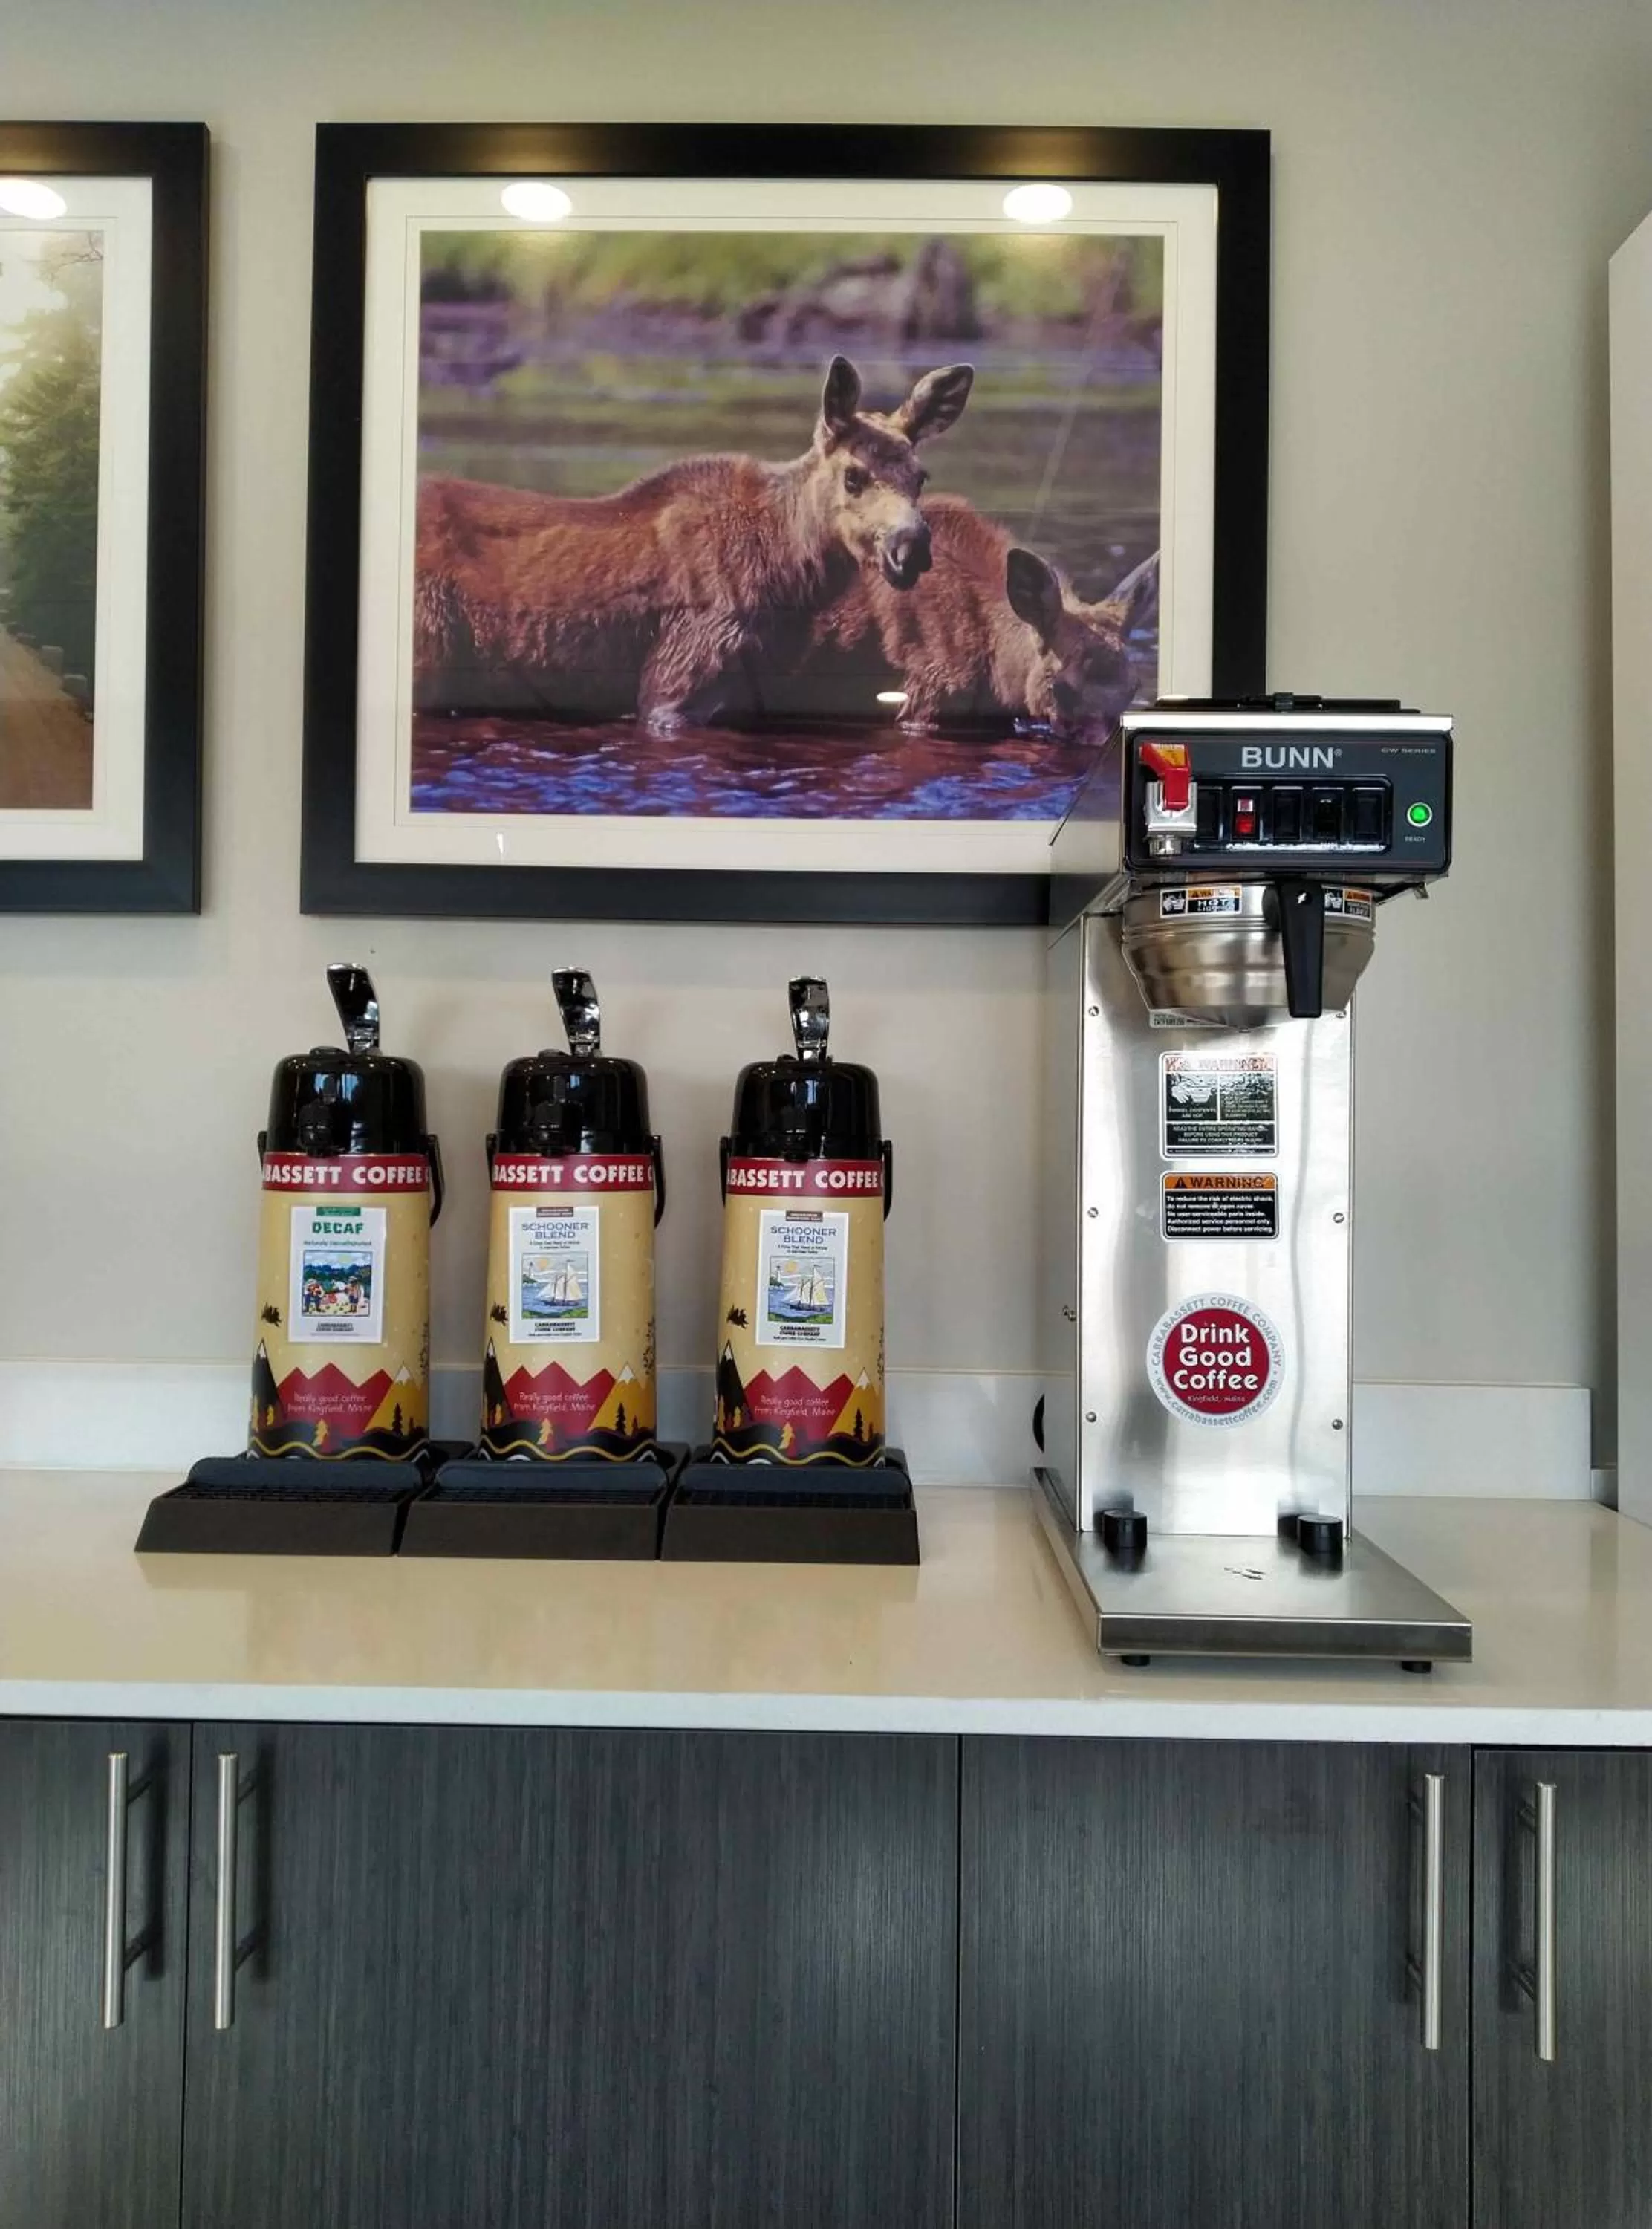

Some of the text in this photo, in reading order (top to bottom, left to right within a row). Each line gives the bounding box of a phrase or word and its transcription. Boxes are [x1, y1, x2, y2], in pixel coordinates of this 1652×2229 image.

[352, 1166, 423, 1184] COFFEE
[573, 1164, 644, 1184] COFFEE
[727, 1169, 806, 1188] BASSETT
[814, 1170, 878, 1189] COFFEE
[1190, 1176, 1264, 1188] WARNING
[312, 1222, 364, 1234] DECAF
[522, 1222, 589, 1231] SCHOONER
[770, 1226, 837, 1236] SCHOONER
[535, 1231, 576, 1239] BLEND
[784, 1235, 824, 1244] BLEND
[1152, 1297, 1281, 1366] CARRABASSETT COFFEE COMPANY
[1180, 1323, 1249, 1343] Drink
[1179, 1346, 1252, 1366] Good
[1174, 1369, 1258, 1389] Coffee
[542, 1392, 562, 1404] good
[565, 1392, 588, 1401] coffee
[784, 1397, 803, 1408] good
[805, 1398, 829, 1406] coffee
[1155, 1378, 1278, 1427] www.carrabassettcoffee.com
